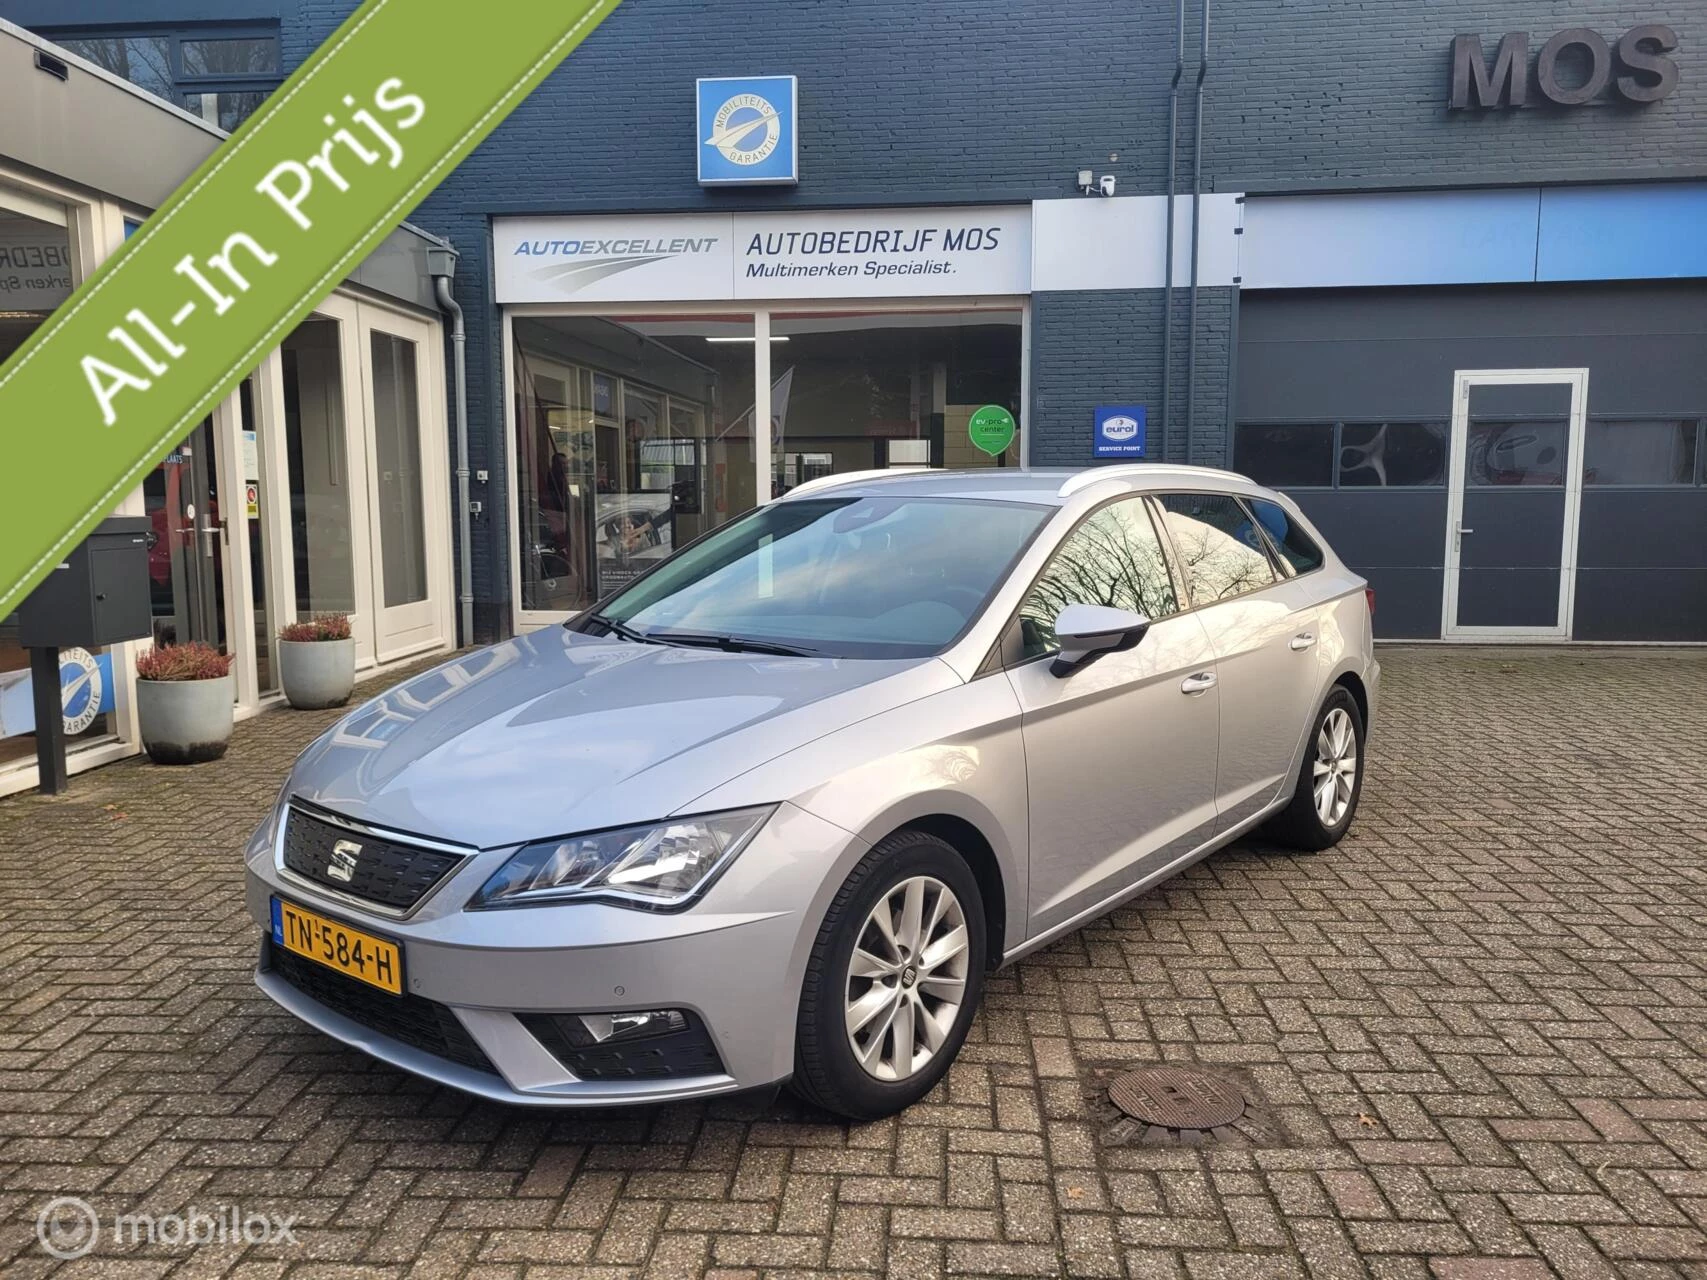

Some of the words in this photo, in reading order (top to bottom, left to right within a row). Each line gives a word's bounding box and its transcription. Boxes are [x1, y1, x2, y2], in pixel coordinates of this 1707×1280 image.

[1450, 23, 1679, 109] MOS
[715, 95, 772, 128] MOBILITEITS
[729, 134, 778, 163] GARANTIE
[514, 237, 719, 256] AUTOEXCELLENT
[746, 229, 938, 256] AUTOBEDRIJF
[942, 227, 1001, 251] MOS
[746, 262, 859, 278] Multimerken
[863, 259, 958, 279] Specialist.
[1105, 424, 1134, 433] eurol
[286, 910, 392, 985] TN-584-H
